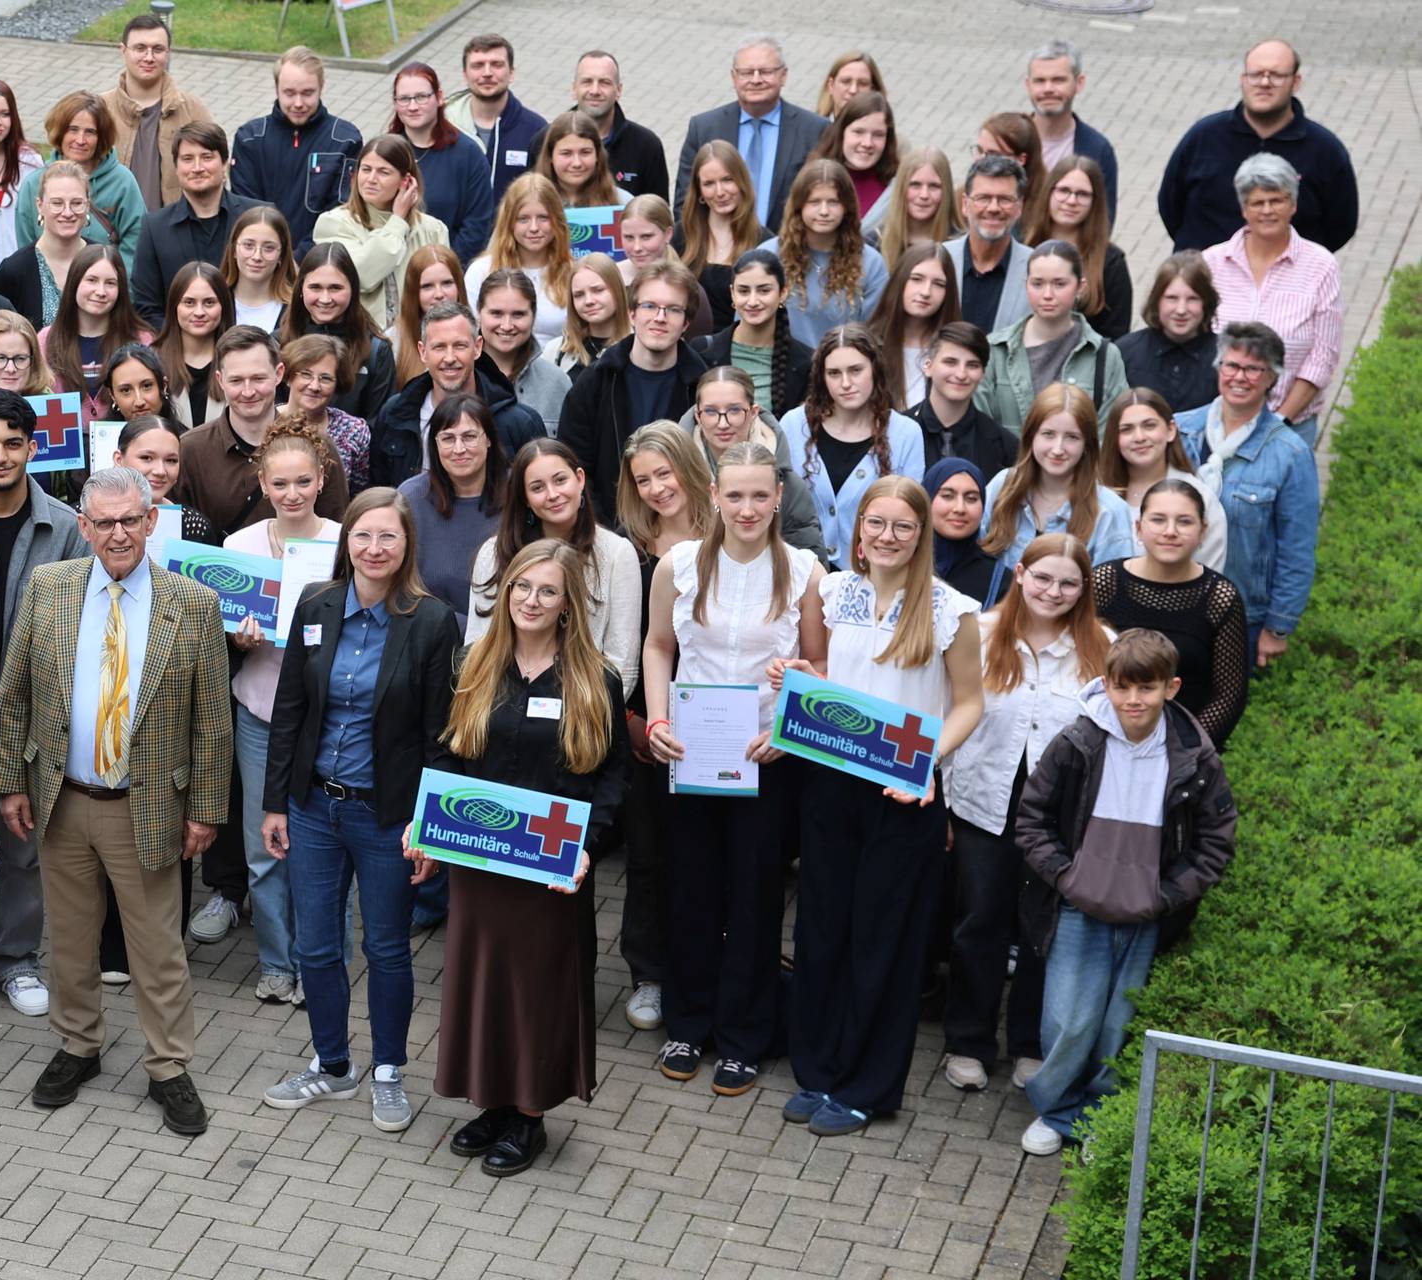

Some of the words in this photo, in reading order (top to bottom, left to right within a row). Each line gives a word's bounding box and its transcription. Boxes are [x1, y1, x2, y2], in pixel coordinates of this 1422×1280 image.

[248, 609, 273, 622] Schule
[787, 719, 867, 758] Humanitäre
[869, 753, 894, 769] Schule
[425, 822, 511, 855] Humanitäre
[513, 848, 540, 862] Schule
